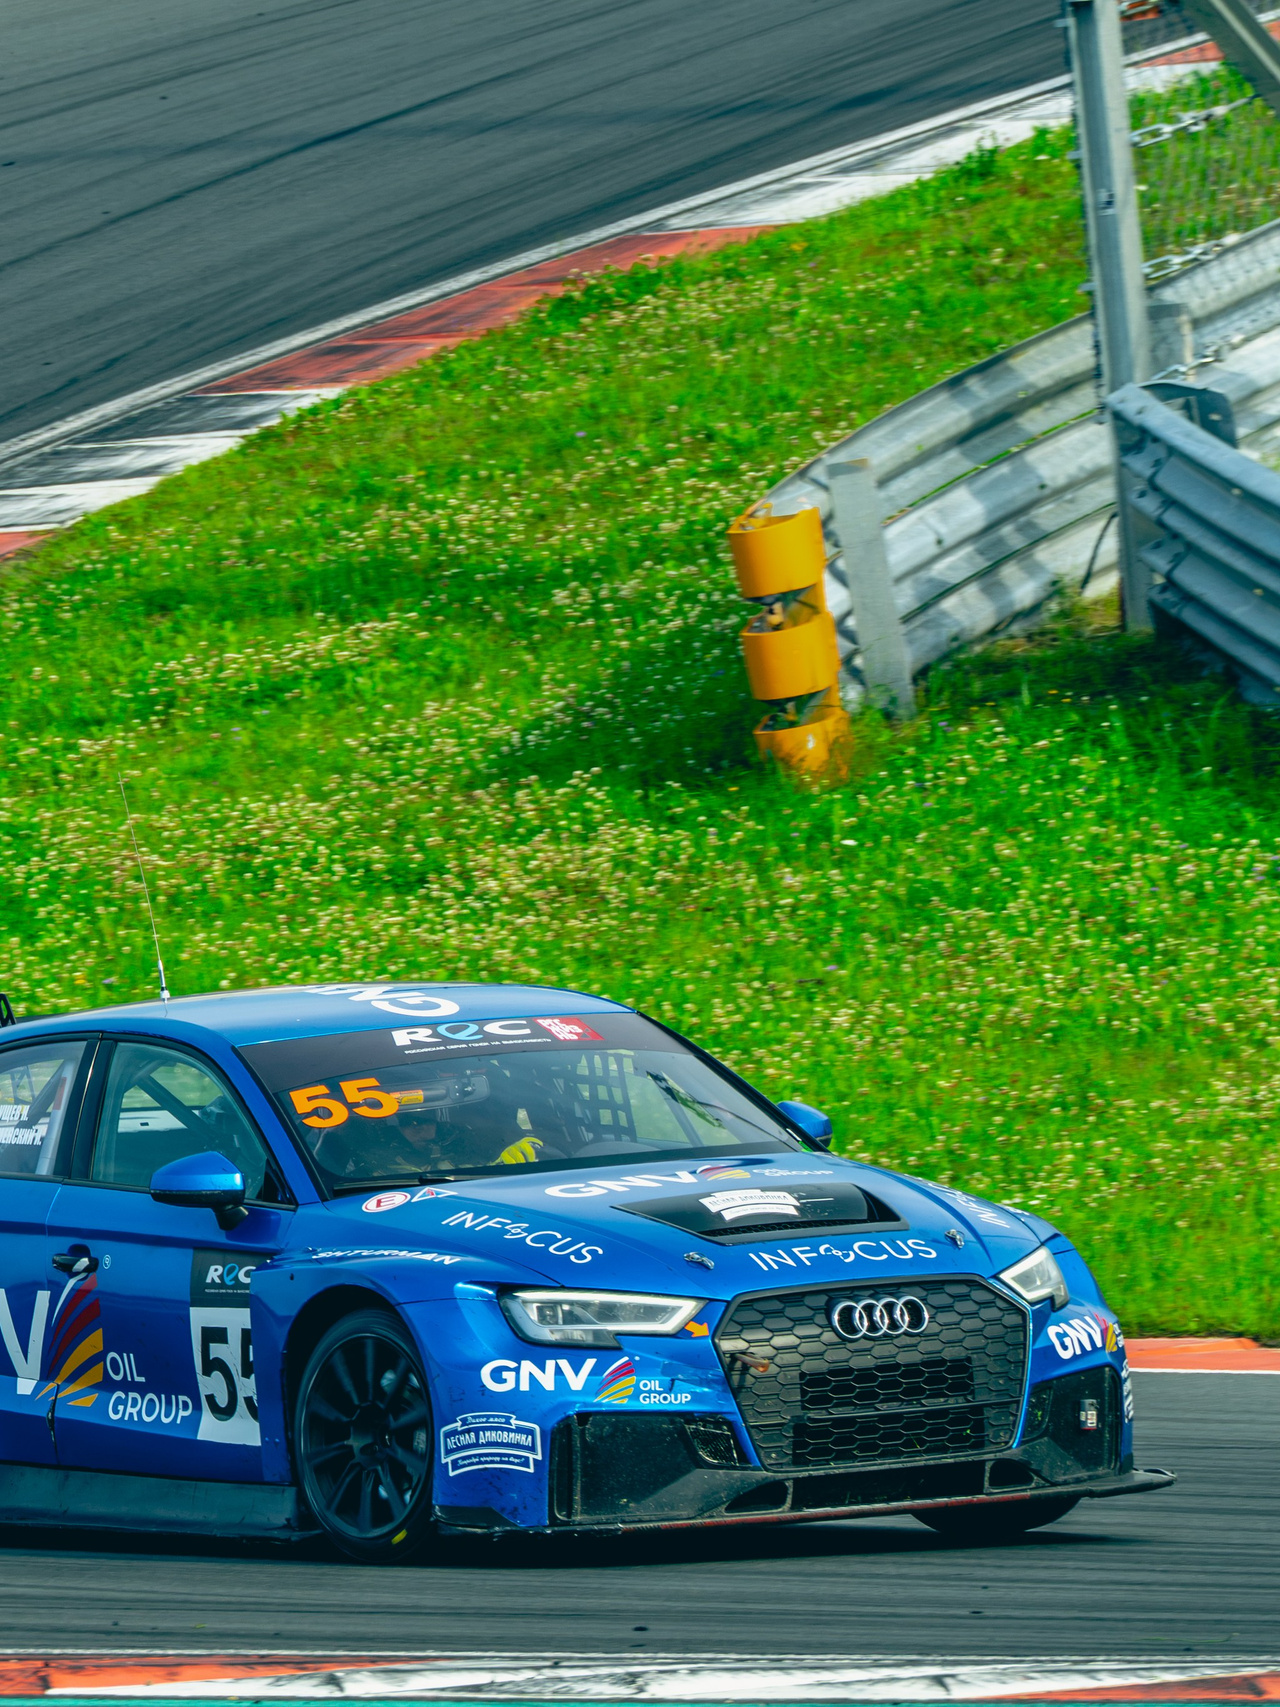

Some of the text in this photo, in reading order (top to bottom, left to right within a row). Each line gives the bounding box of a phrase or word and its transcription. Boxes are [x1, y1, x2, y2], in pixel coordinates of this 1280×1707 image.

[289, 1077, 399, 1128] 55
[544, 1171, 698, 1198] GNV
[375, 1194, 396, 1209] E
[312, 1248, 462, 1265] SHTURMAN
[1047, 1315, 1102, 1359] GNV
[106, 1352, 146, 1382] OIL
[480, 1358, 597, 1392] GNV
[639, 1380, 664, 1391] OIL
[639, 1393, 691, 1404] GROUP
[108, 1390, 193, 1424] GROUP
[447, 1430, 532, 1450] ЛЕСНАЯ ДИКОВИНКА
